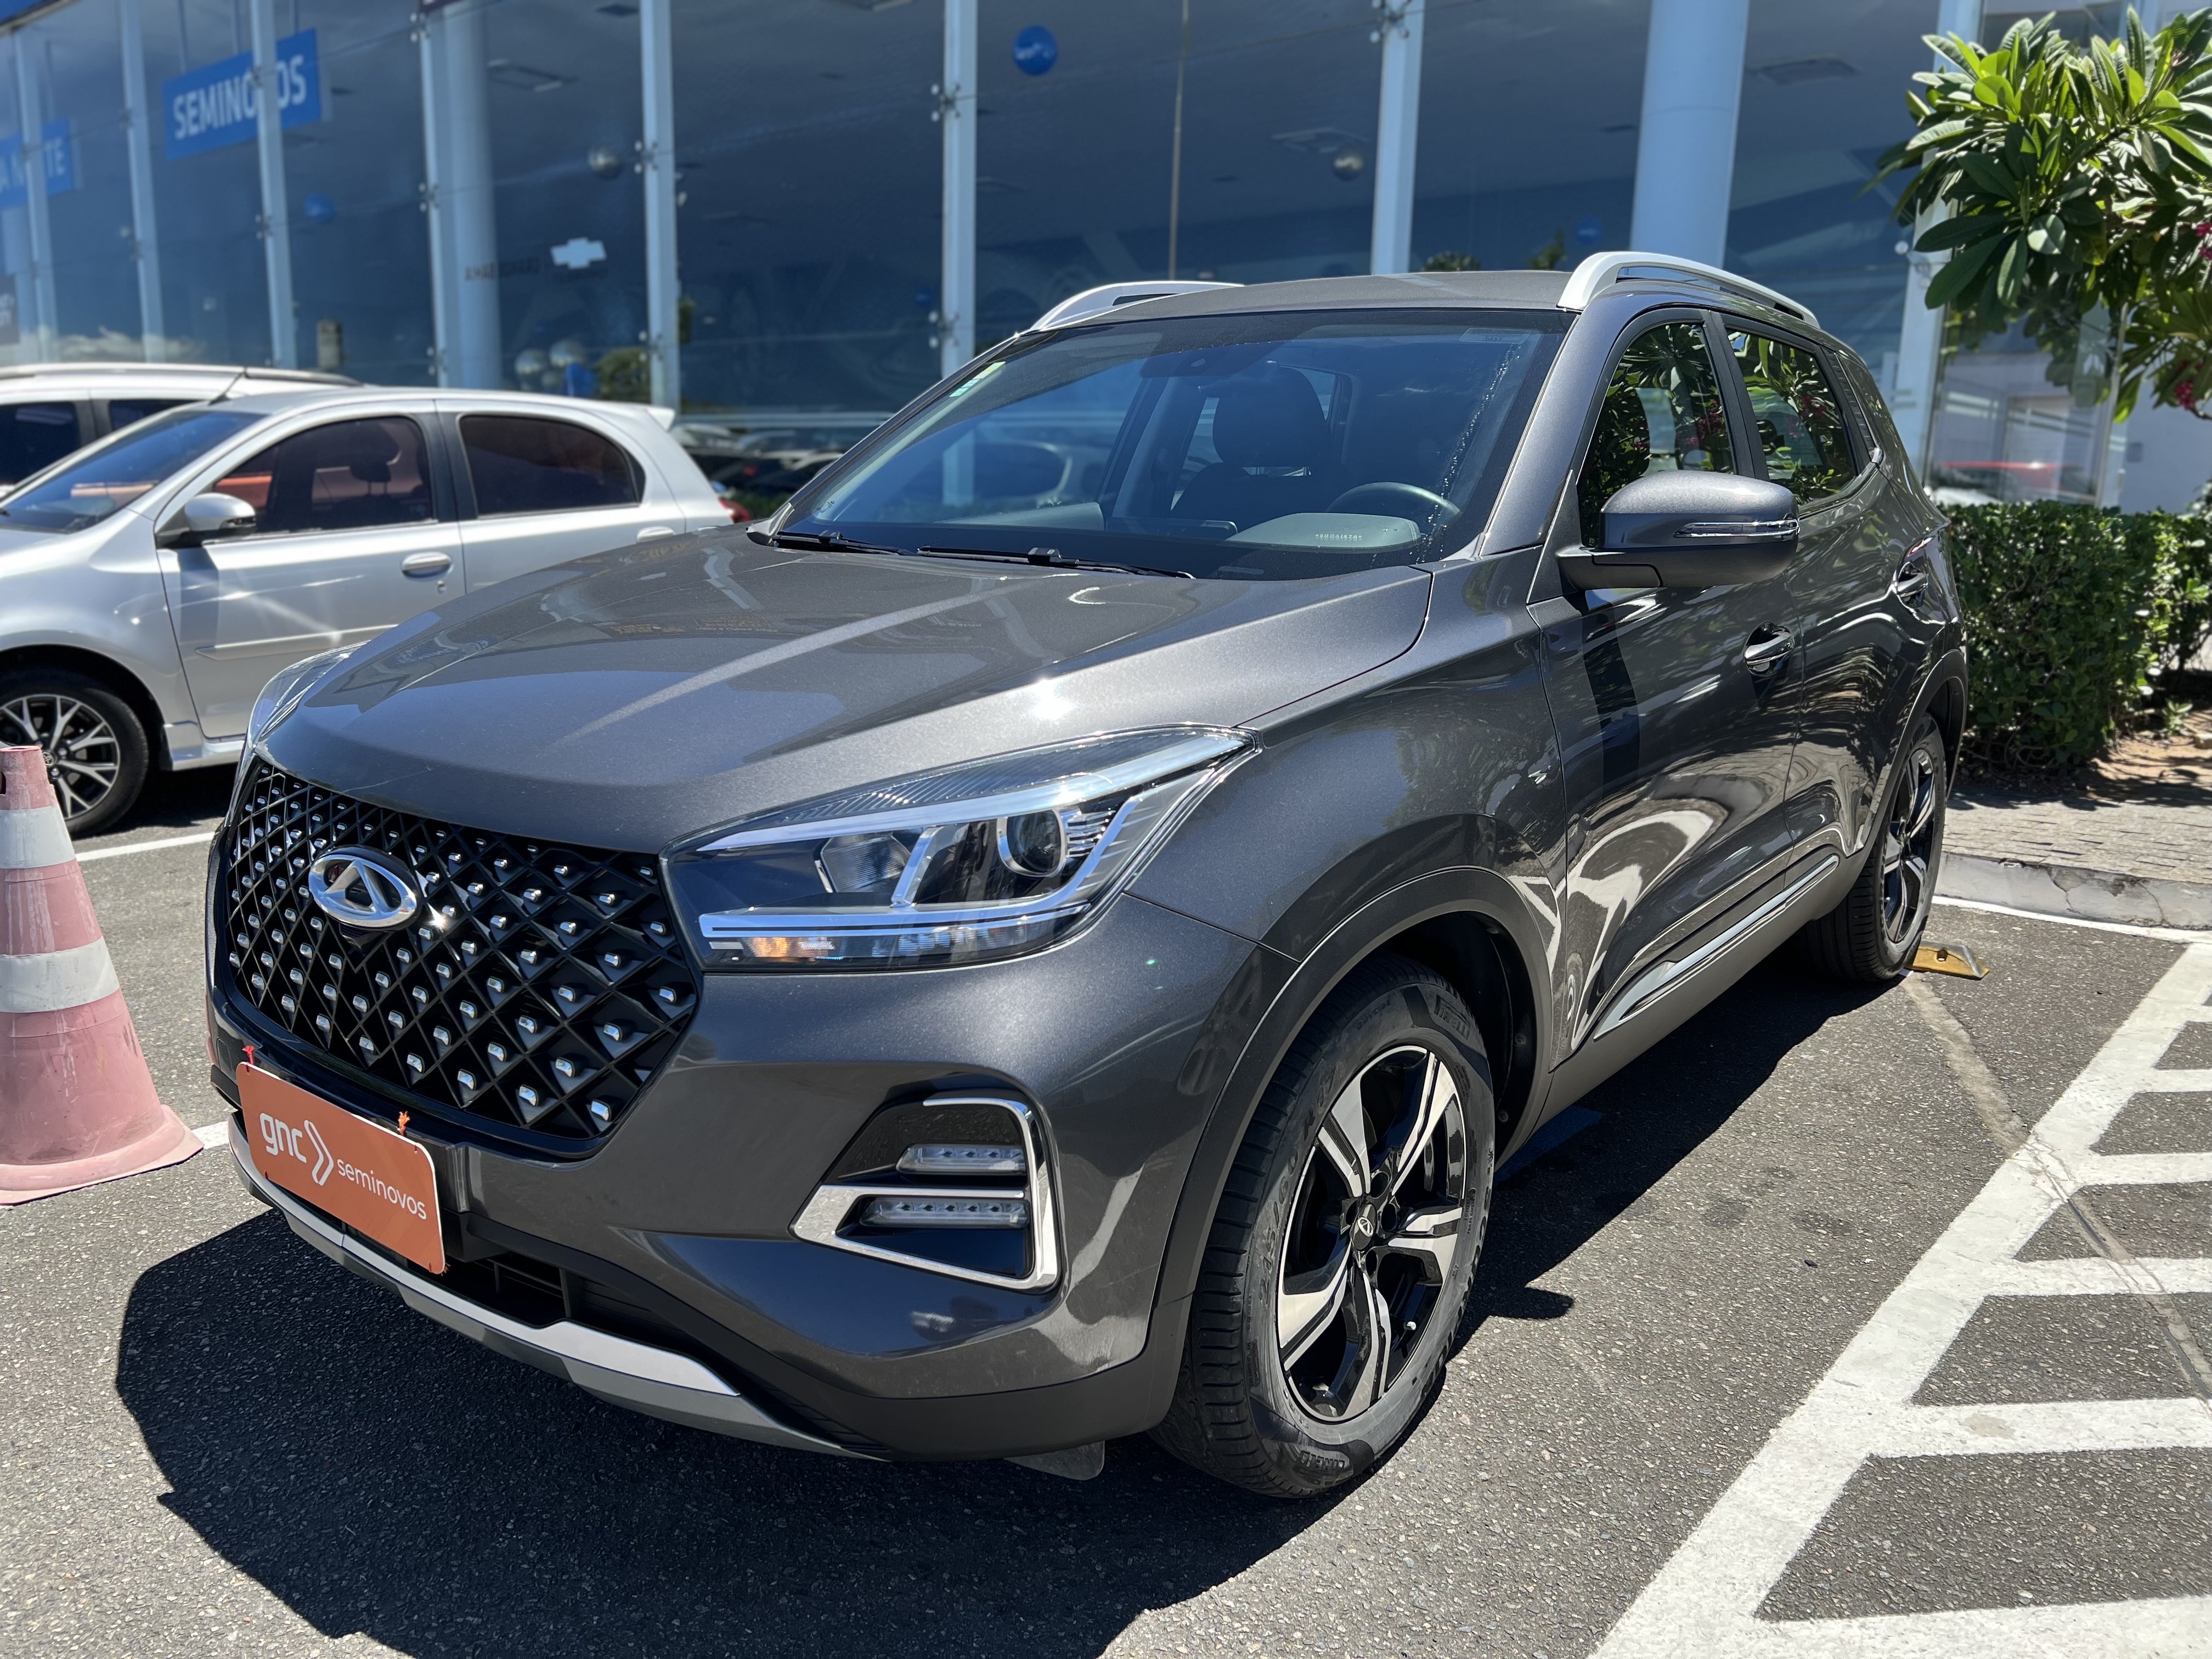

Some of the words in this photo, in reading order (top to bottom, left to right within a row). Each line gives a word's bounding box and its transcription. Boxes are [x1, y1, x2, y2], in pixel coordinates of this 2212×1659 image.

[172, 54, 306, 139] SEMINOOS
[259, 1112, 307, 1164] gnc
[336, 1158, 427, 1221] seminovos
